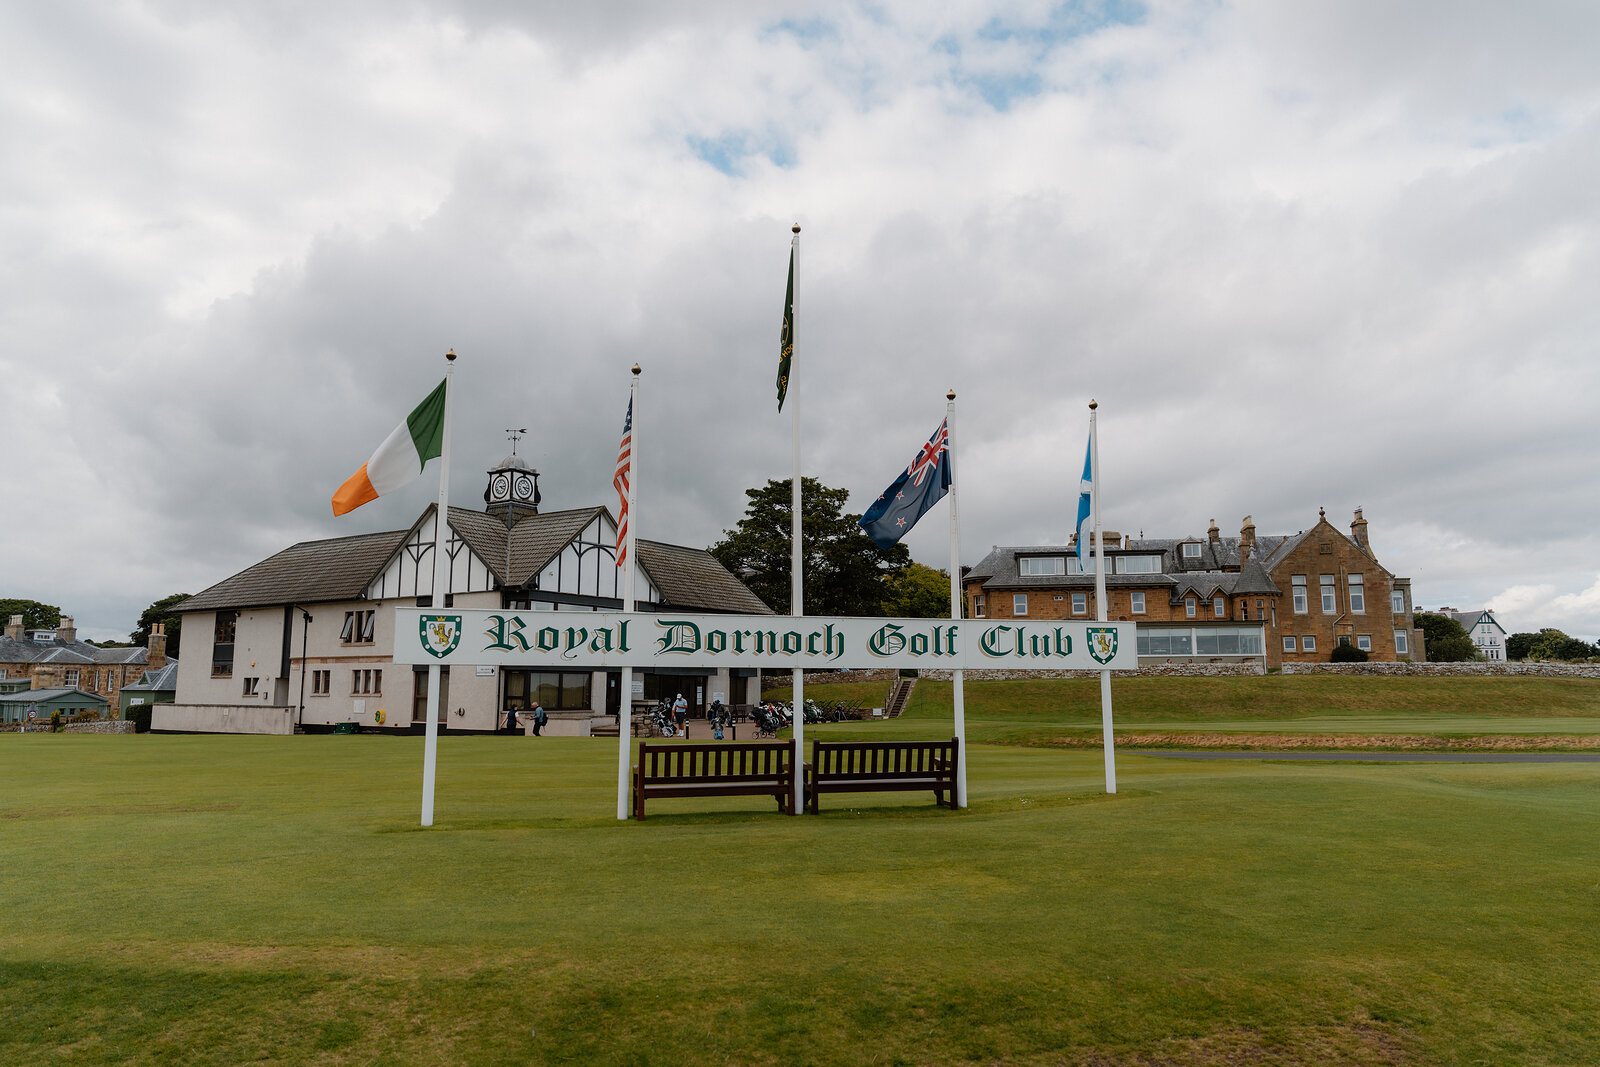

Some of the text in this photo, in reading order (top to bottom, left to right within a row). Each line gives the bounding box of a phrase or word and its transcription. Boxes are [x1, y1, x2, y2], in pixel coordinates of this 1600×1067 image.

[481, 615, 1073, 662] Royal Dornoch Golf Club
